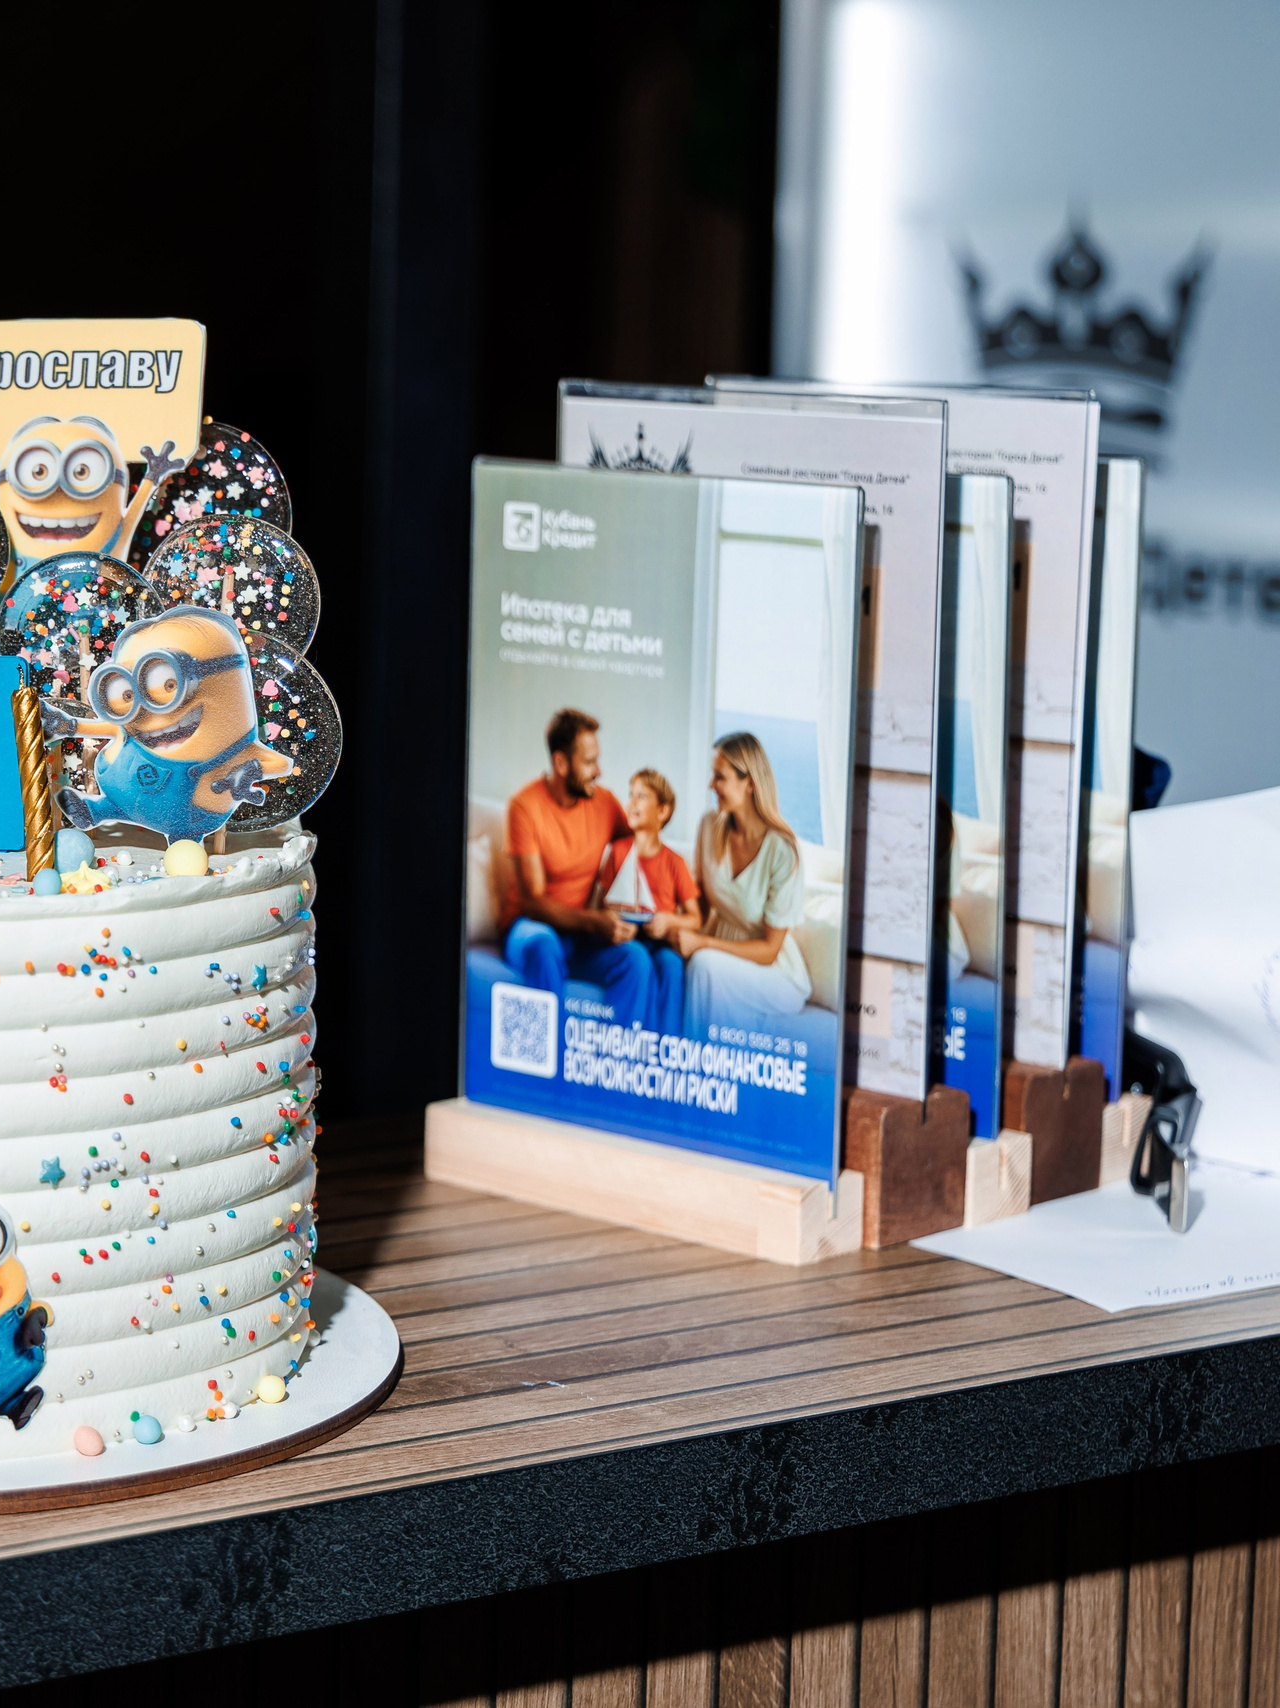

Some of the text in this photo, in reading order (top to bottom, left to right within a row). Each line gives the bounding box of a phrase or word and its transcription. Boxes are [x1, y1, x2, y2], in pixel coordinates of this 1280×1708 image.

[500, 590, 632, 630] Ипотека для
[500, 619, 663, 657] семей с детьми
[563, 1048, 673, 1103] ВОЗМОЖНОСТИ
[687, 1073, 739, 1116] РИСКИ
[564, 1016, 807, 1096] ОЦЕНИВАЙТЕ СВОИ ФИНАНСОВЫЕ
